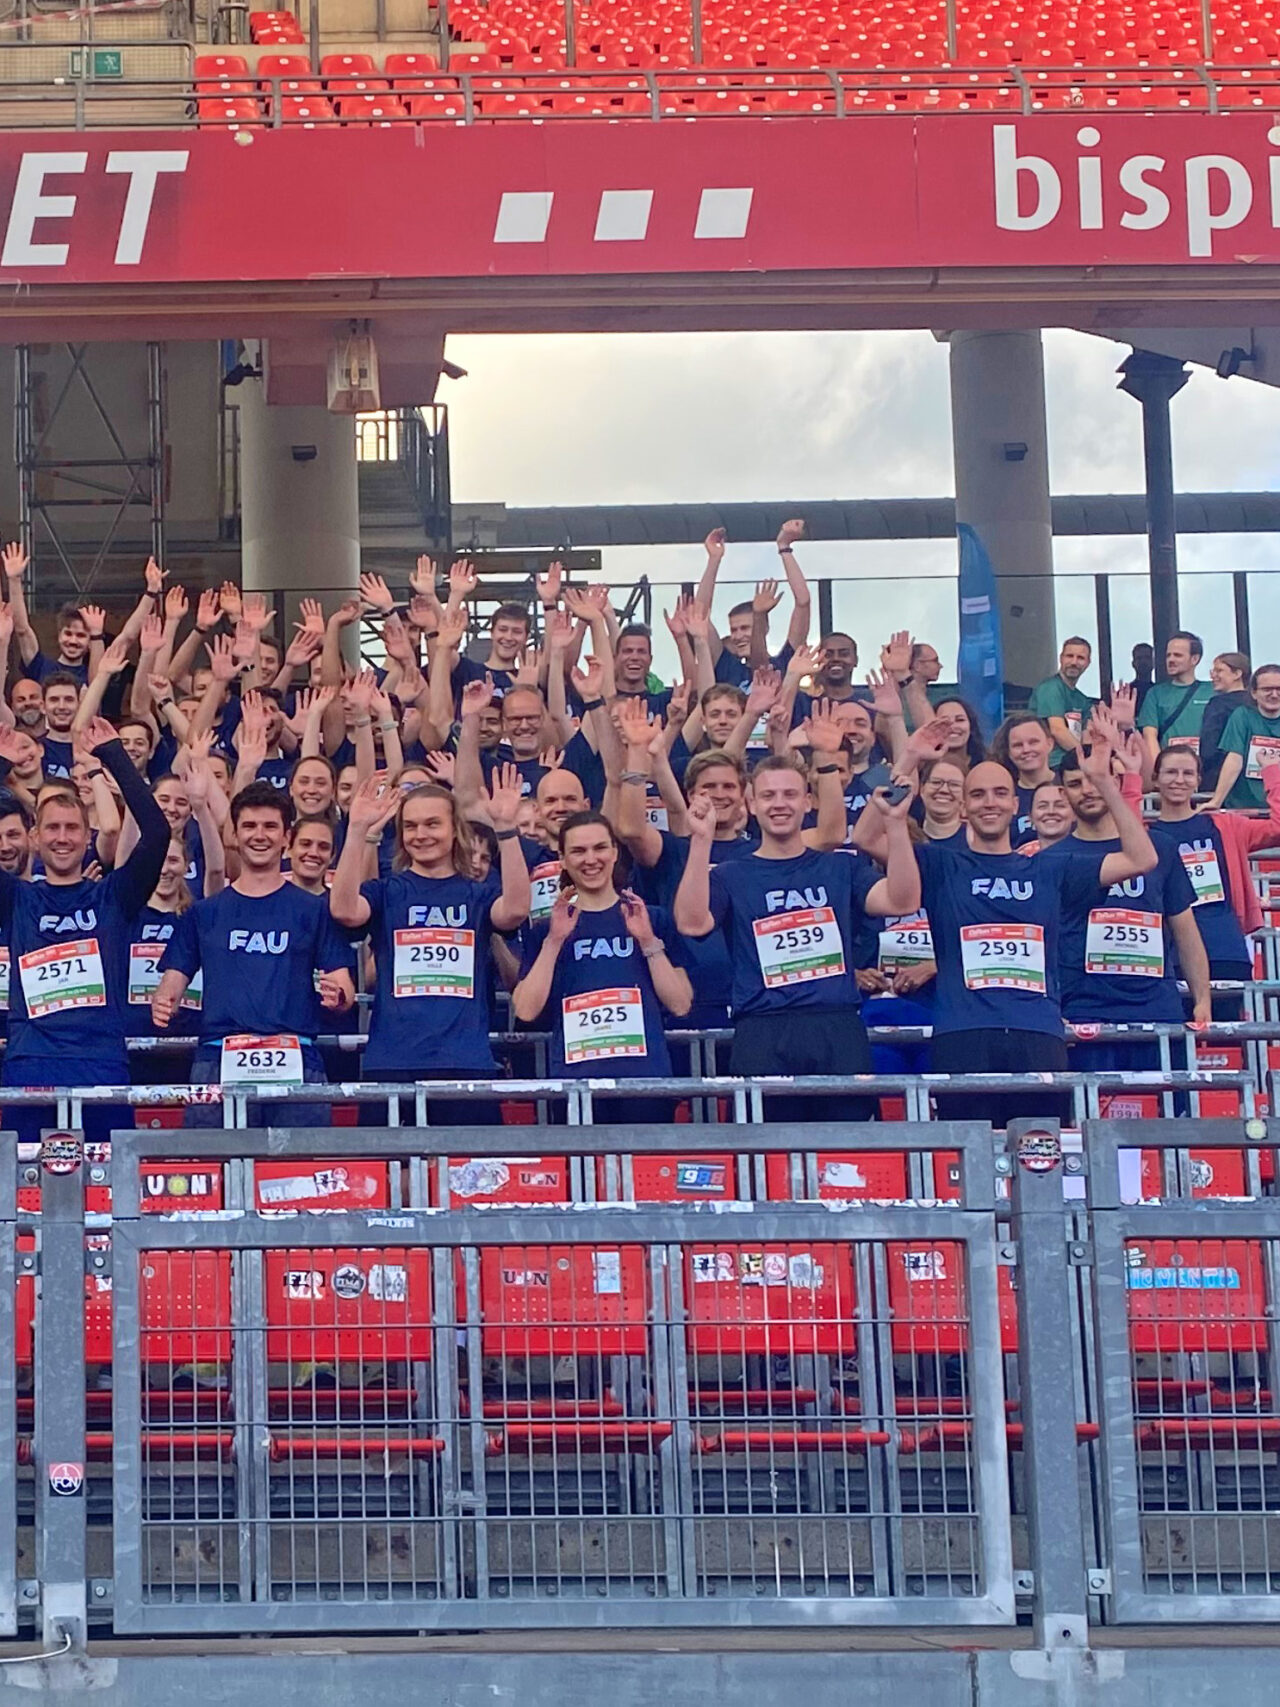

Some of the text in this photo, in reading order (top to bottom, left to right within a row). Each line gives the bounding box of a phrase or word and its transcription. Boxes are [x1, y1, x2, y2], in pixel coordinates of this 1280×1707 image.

[1178, 838, 1213, 852] AU
[971, 877, 1034, 901] FAU
[1107, 875, 1145, 898] AU
[765, 886, 828, 912] FAU
[39, 909, 98, 934] FAU
[408, 904, 468, 927] FAU
[142, 924, 174, 940] FA
[229, 930, 289, 954] FAU
[773, 927, 825, 950] 2539
[896, 932, 932, 945] 261
[1103, 925, 1150, 943] 2555
[410, 945, 460, 962] 2590
[573, 936, 635, 960] FAU
[980, 941, 1031, 957] 2591
[37, 959, 88, 981] 2571
[578, 1006, 629, 1028] 2625
[236, 1050, 287, 1068] 2632
[55, 1477, 79, 1488] FCN
